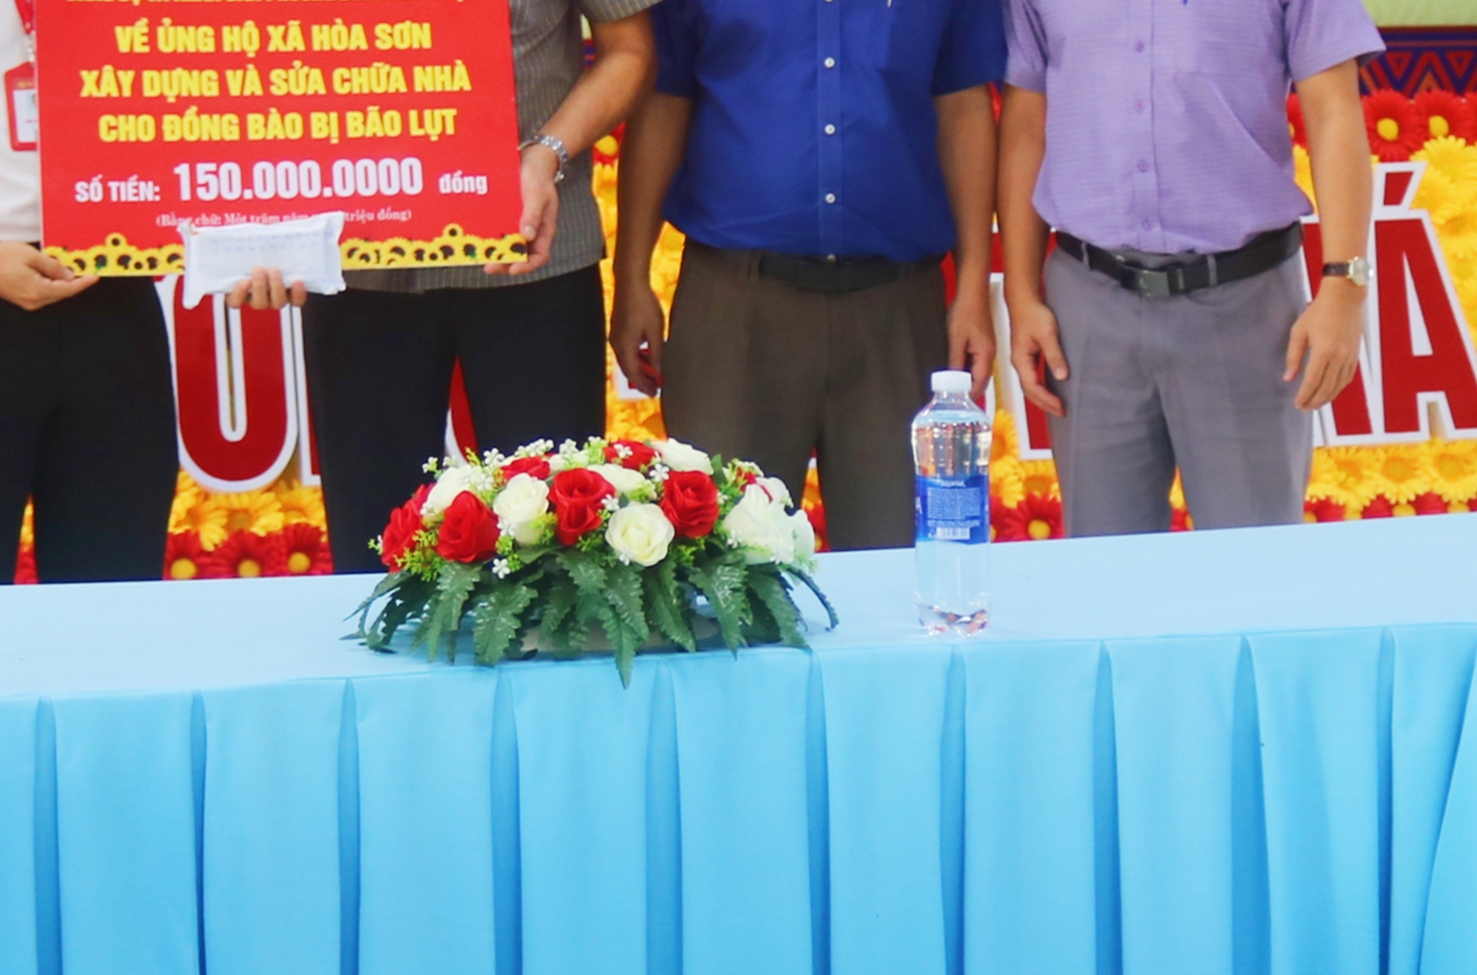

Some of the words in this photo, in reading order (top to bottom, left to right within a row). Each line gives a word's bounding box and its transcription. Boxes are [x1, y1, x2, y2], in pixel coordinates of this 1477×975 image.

[115, 18, 150, 53] VỀ
[157, 18, 215, 53] ỦNG
[222, 20, 260, 58] HỘ
[267, 20, 306, 52] XÃ
[311, 18, 368, 51] HÒA
[374, 20, 432, 50] SƠN
[80, 65, 135, 97] XÂY
[142, 67, 219, 103] DỰNG
[225, 64, 263, 96] VÀ
[269, 60, 326, 96] SỬA
[332, 62, 407, 94] CHỮA
[413, 60, 472, 92] NHÀ
[99, 114, 156, 142] CHO
[162, 105, 240, 141] ĐỒNG
[247, 108, 303, 140] BÀO
[310, 112, 339, 144] BỊ
[346, 106, 402, 138] BÃO
[409, 108, 457, 141] LỤT
[75, 175, 103, 202] SỐ
[108, 175, 160, 201] TIỀN:
[174, 157, 423, 200] 150.000.0000
[439, 170, 487, 194] đồng
